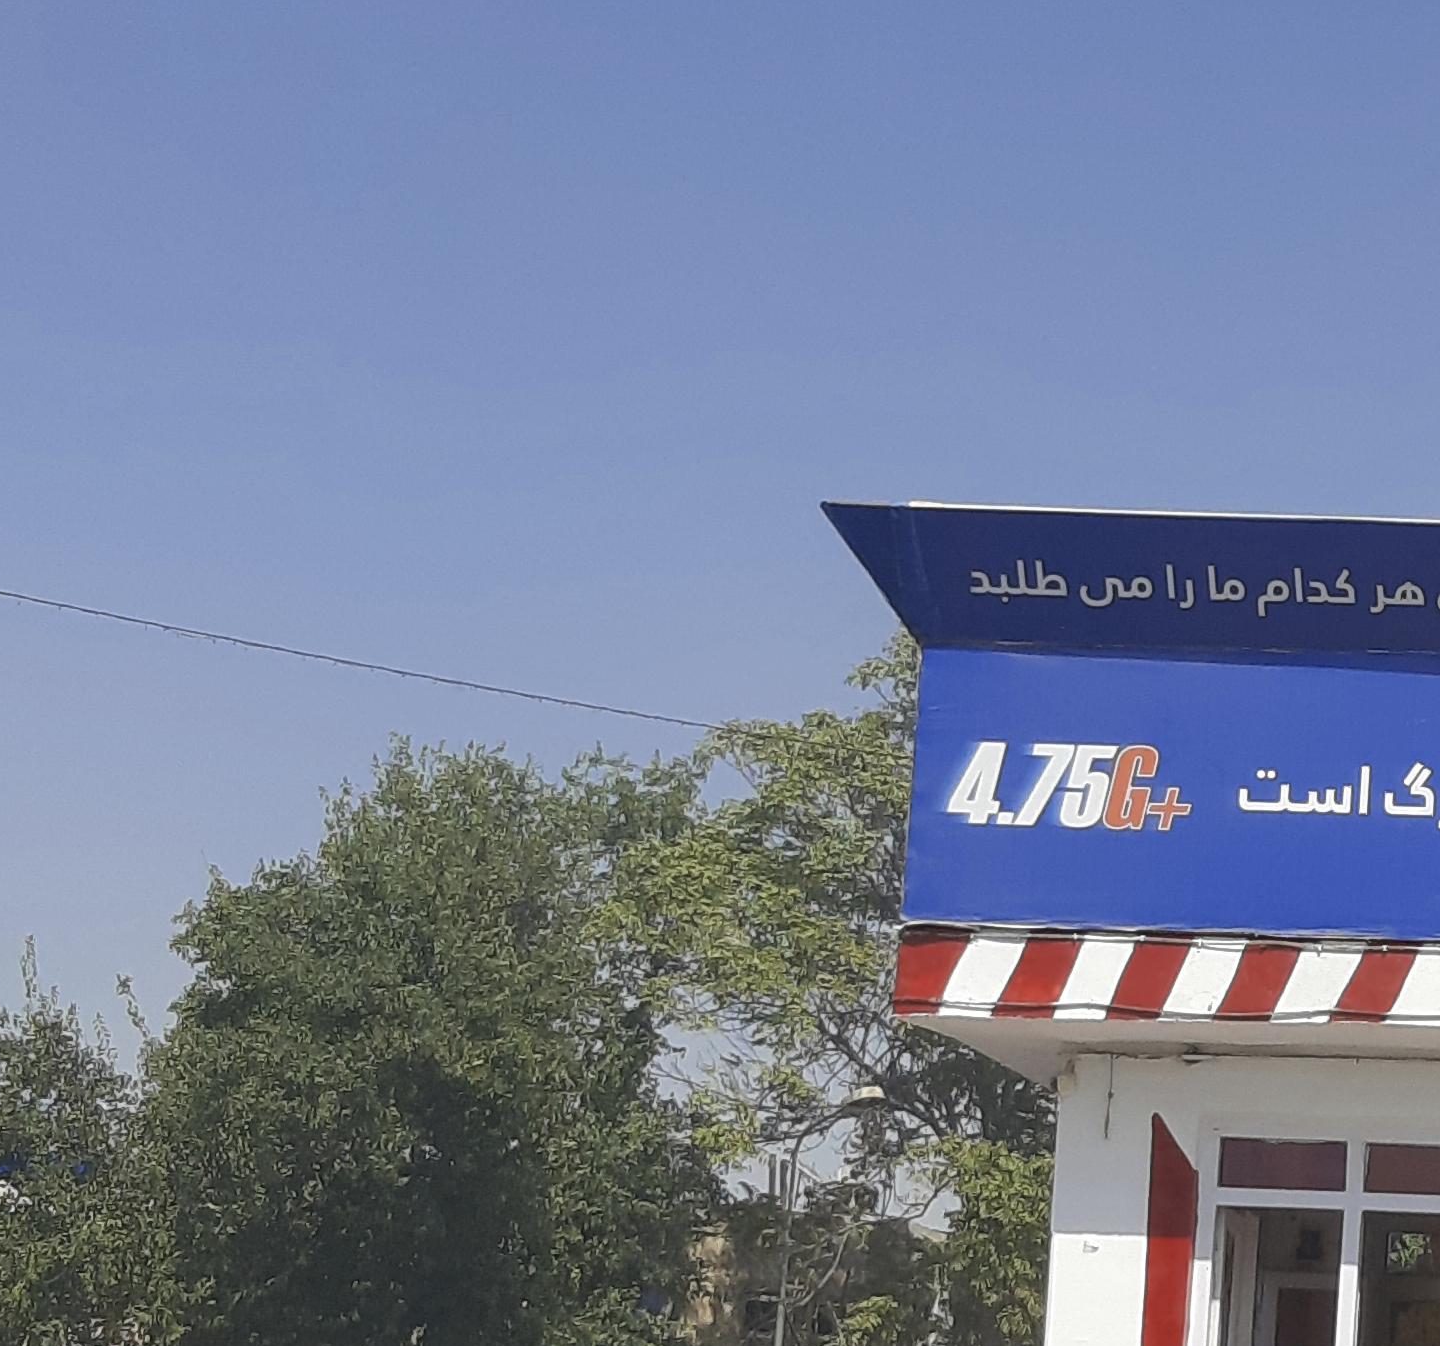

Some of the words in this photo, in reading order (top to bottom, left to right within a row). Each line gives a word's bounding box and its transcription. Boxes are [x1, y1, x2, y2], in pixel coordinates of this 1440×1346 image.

[968, 559, 1069, 604] طلبد
[1077, 575, 1154, 608] می
[1163, 562, 1196, 609] را
[1207, 565, 1247, 603] ما
[1256, 567, 1358, 617] کدام
[1367, 581, 1426, 616] هر
[1237, 764, 1372, 816] است
